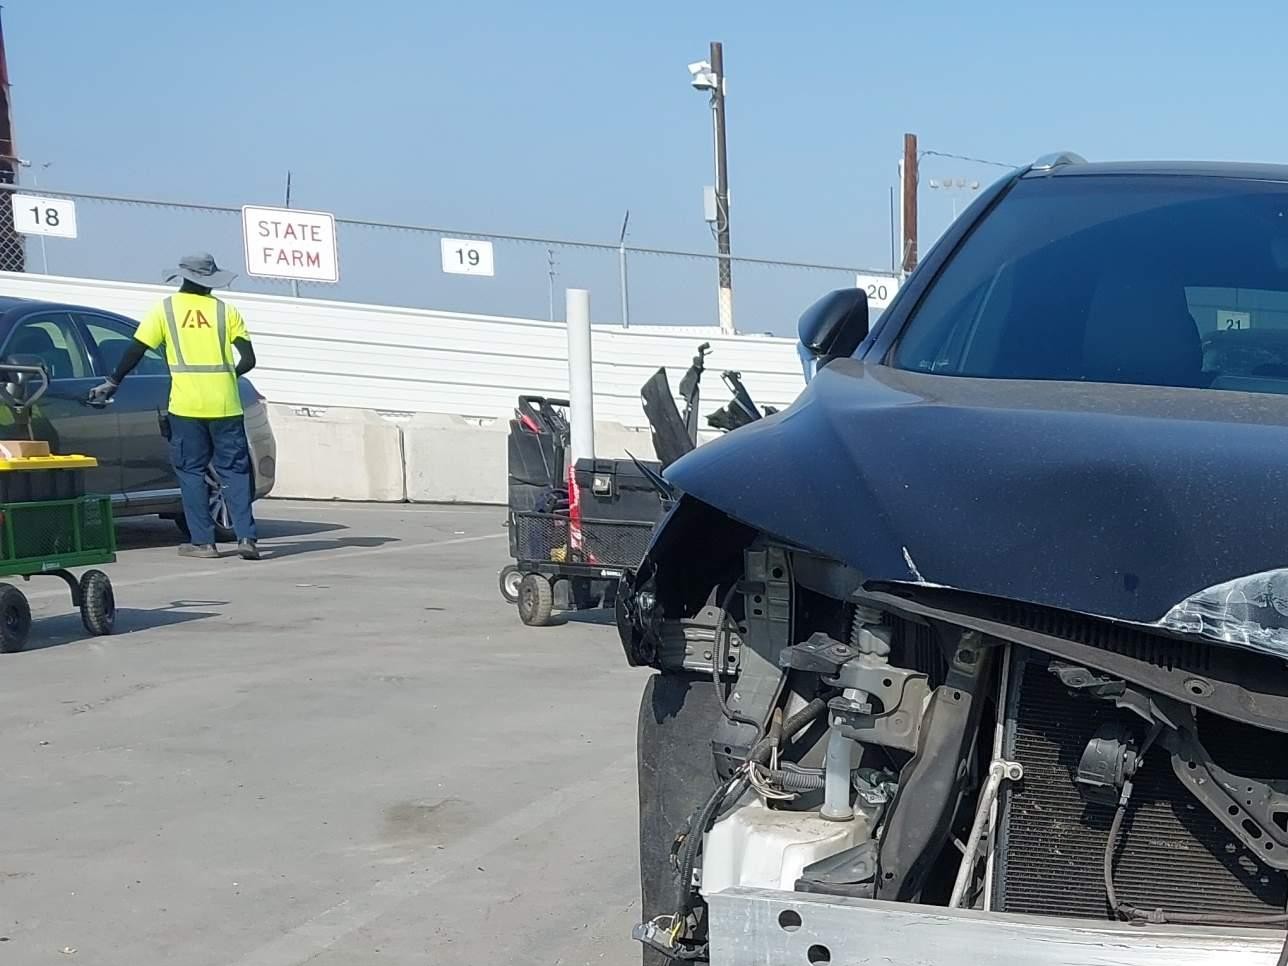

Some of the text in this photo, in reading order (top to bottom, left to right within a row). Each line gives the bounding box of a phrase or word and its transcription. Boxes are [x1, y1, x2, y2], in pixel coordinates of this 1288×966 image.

[29, 206, 60, 226] 18
[258, 220, 323, 242] STATE
[263, 247, 321, 268] FARM
[455, 247, 480, 266] 19
[867, 284, 888, 301] 20
[1226, 319, 1241, 330] 21
